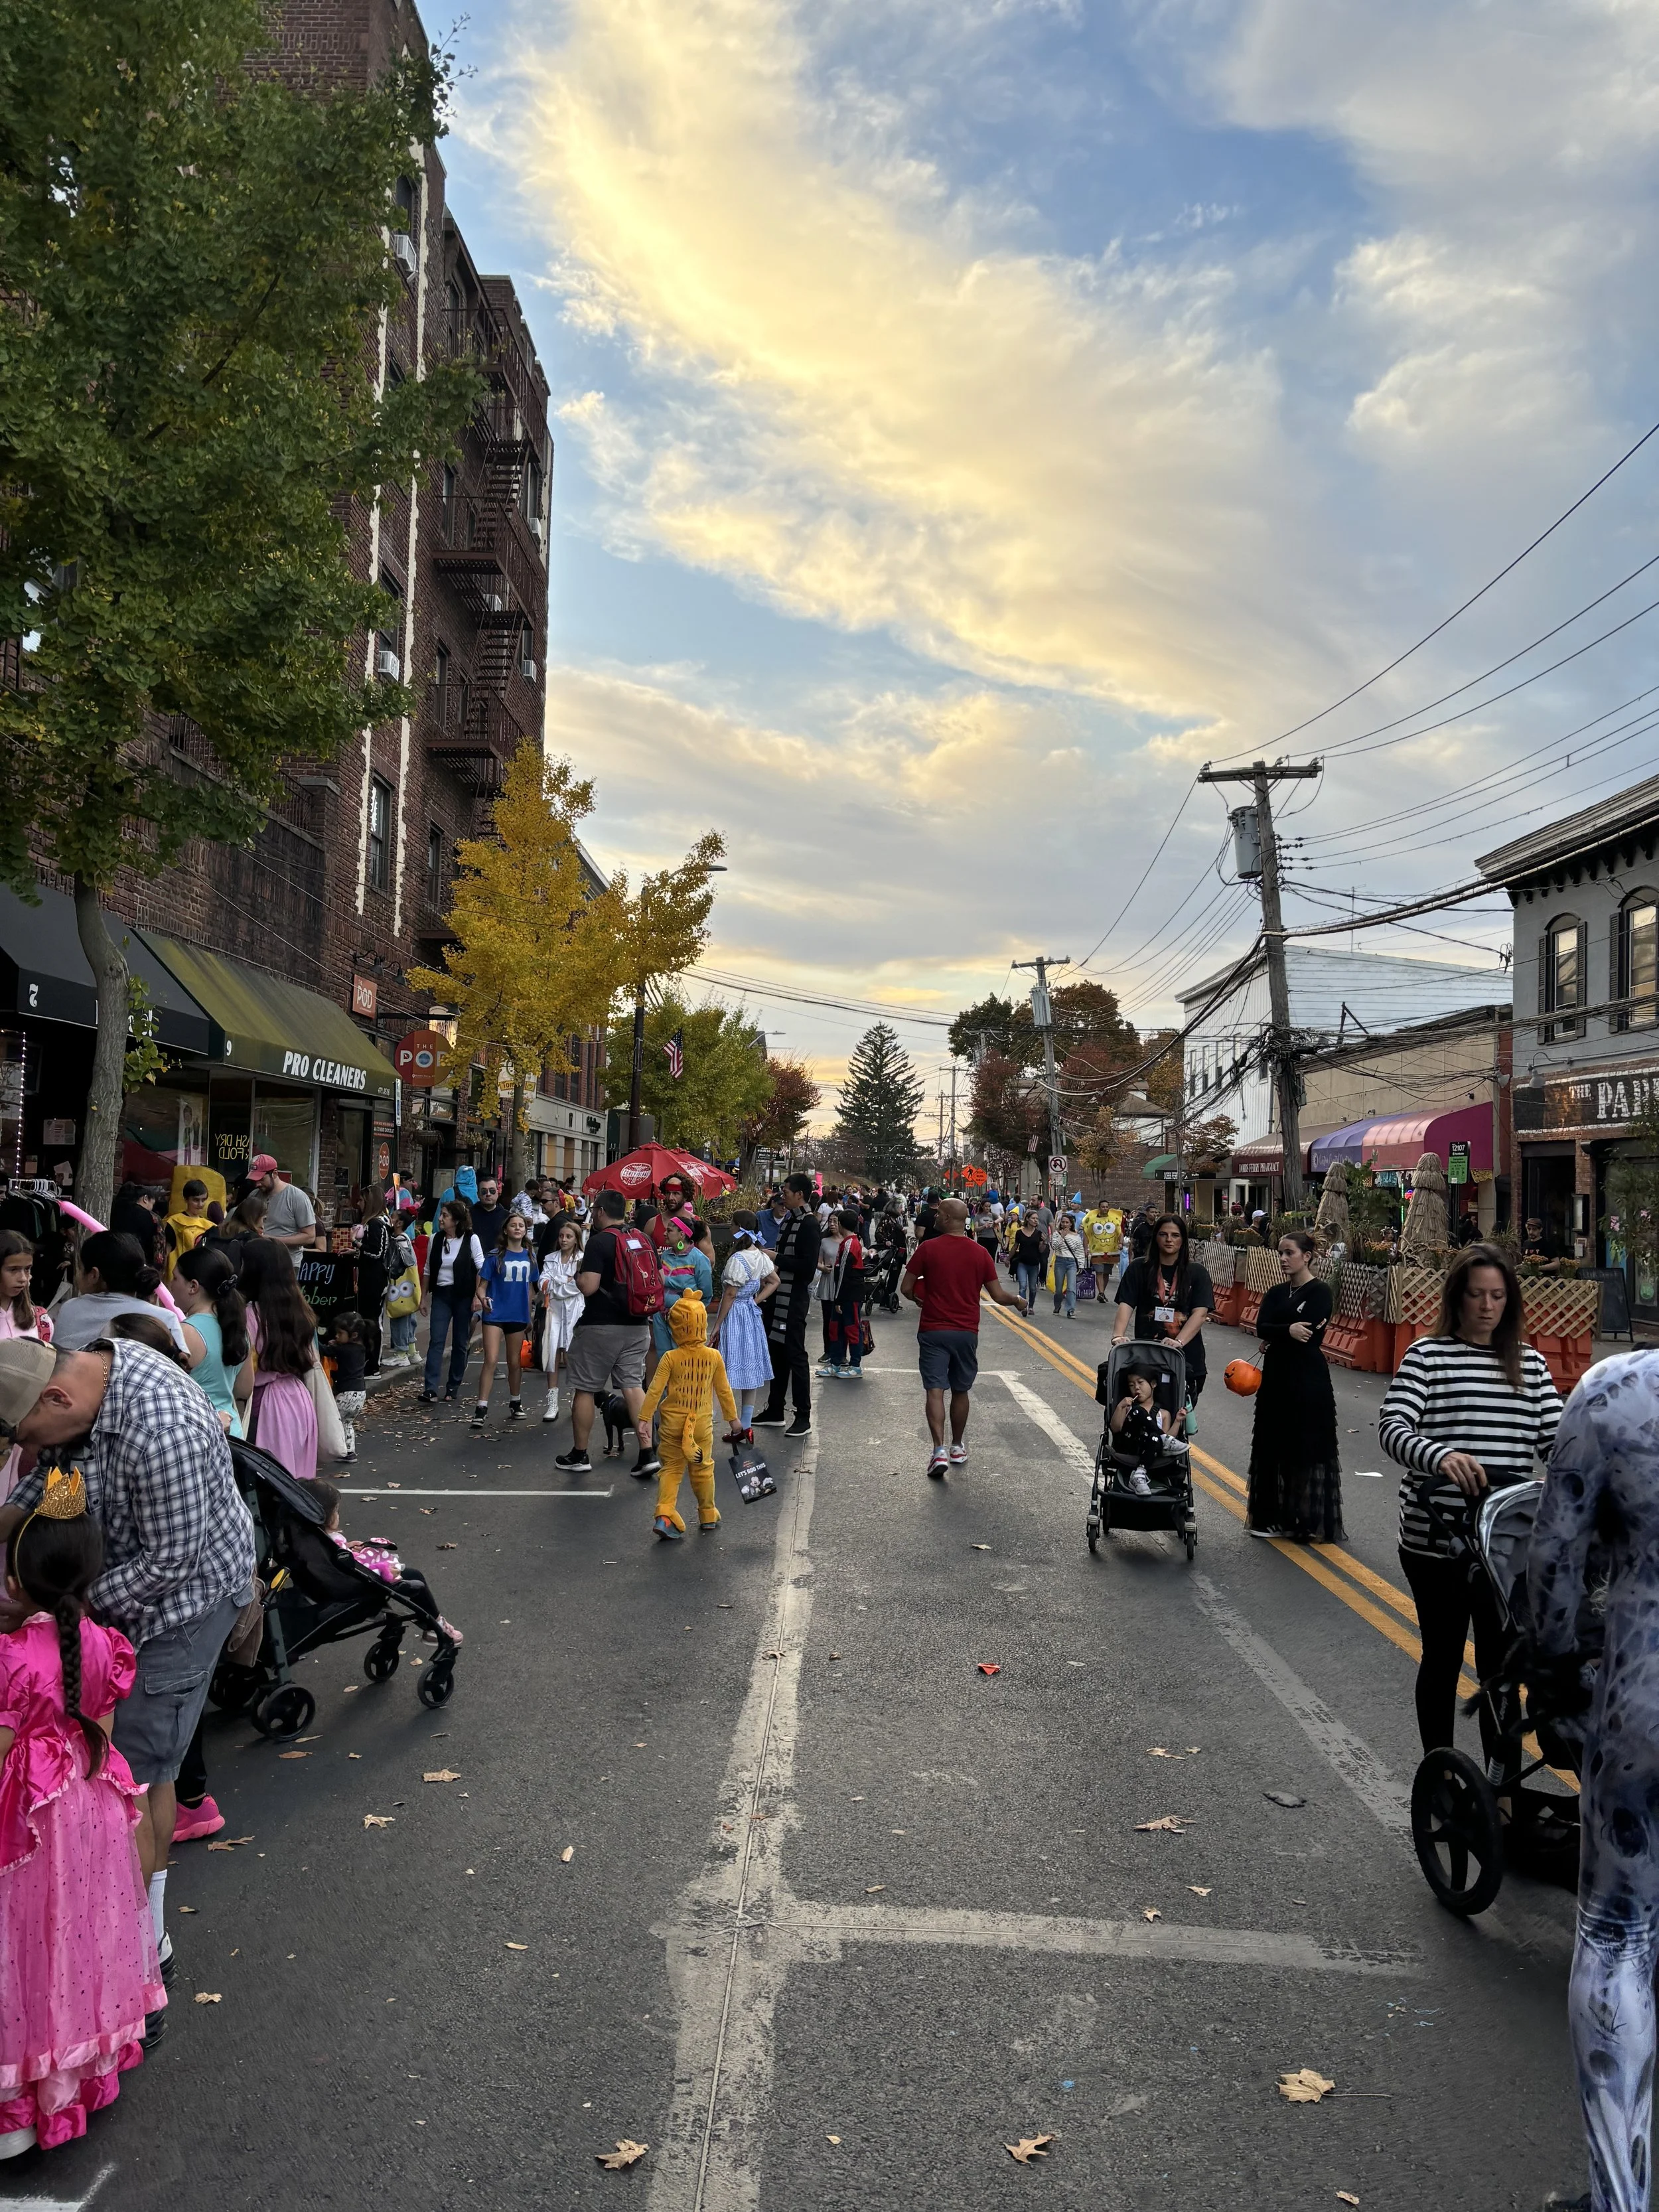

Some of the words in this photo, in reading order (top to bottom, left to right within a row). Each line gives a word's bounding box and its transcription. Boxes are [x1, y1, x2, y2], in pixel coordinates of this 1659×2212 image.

[29, 984, 38, 1007] 7
[356, 986, 373, 1009] POD
[226, 1040, 232, 1057] 9
[283, 1051, 309, 1078] PRO
[313, 1059, 367, 1090] CLEANERS
[1568, 1083, 1592, 1102] THE
[379, 1155, 390, 1166] POD
[504, 1260, 530, 1282] m
[735, 1469, 747, 1479] LET'S
